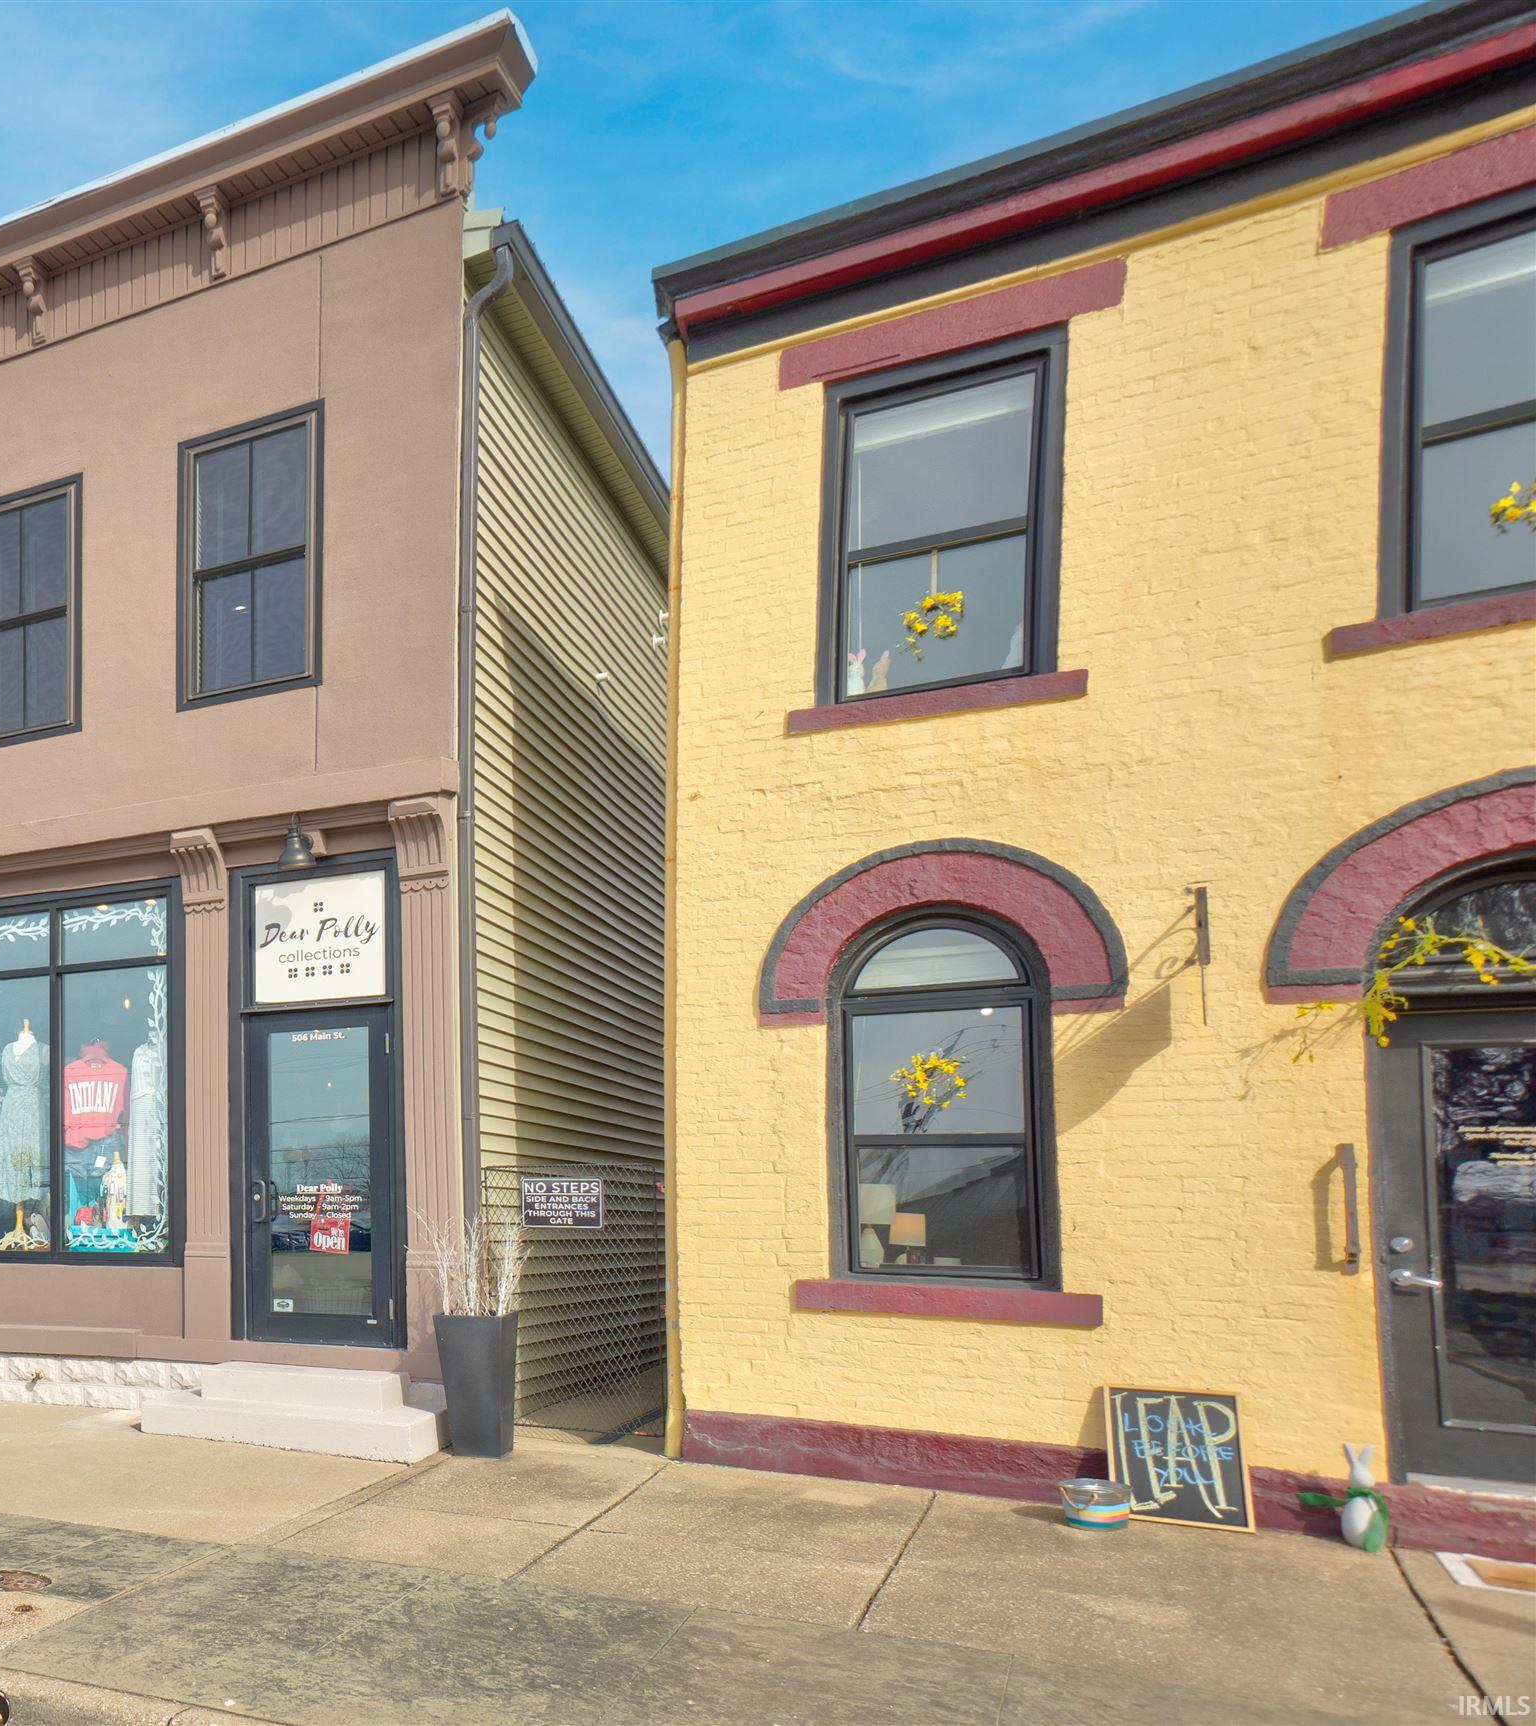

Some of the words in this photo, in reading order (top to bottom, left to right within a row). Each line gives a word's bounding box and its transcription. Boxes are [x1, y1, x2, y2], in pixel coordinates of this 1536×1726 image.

[259, 923, 309, 948] Dear
[316, 915, 381, 945] Polly
[278, 946, 360, 964] collections
[292, 1033, 308, 1042] 506
[309, 1030, 331, 1041] Main
[333, 1031, 345, 1040] St.
[296, 1184, 319, 1193] Dear
[319, 1182, 343, 1194] Polly
[524, 1181, 547, 1194] NO
[551, 1181, 600, 1194] STEPS
[278, 1195, 317, 1204] Weekdays
[526, 1195, 546, 1203] SIDE
[549, 1195, 569, 1203] AND
[571, 1195, 598, 1203] BACK
[282, 1203, 316, 1212] Saturday
[322, 1203, 359, 1212] 9am-2pm
[289, 1211, 317, 1220] Sunday
[326, 1211, 352, 1219] Closed
[575, 1210, 596, 1218] THIS
[549, 1217, 574, 1225] GATE
[313, 1231, 346, 1251] Open
[1111, 1391, 1239, 1519] LEAP
